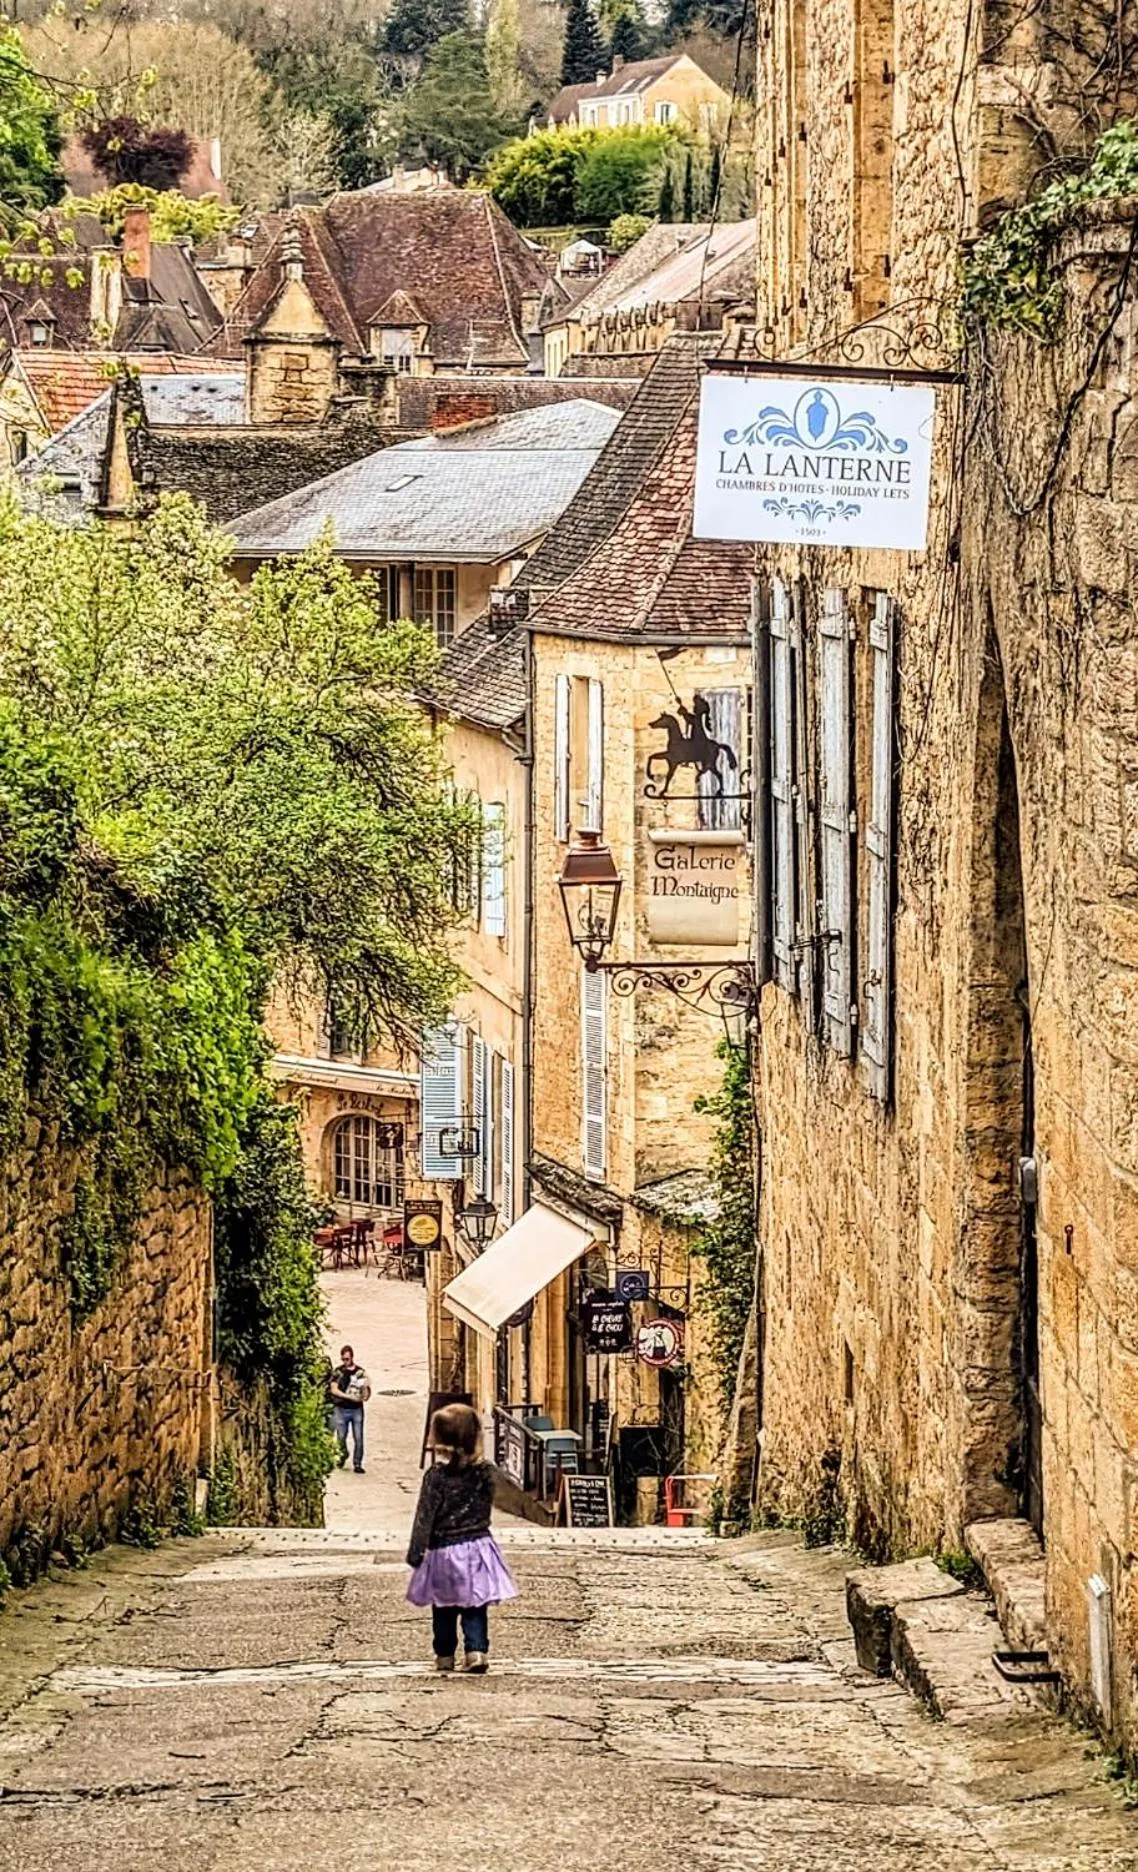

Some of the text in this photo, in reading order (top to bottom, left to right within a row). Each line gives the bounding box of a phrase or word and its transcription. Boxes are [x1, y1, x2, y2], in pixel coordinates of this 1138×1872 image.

[718, 450, 911, 484] LA LANTERNE
[715, 478, 776, 492] CHAMBRES
[831, 485, 880, 499] HOLIDAY
[883, 488, 910, 500] LETS
[650, 875, 740, 905] Montaigne
